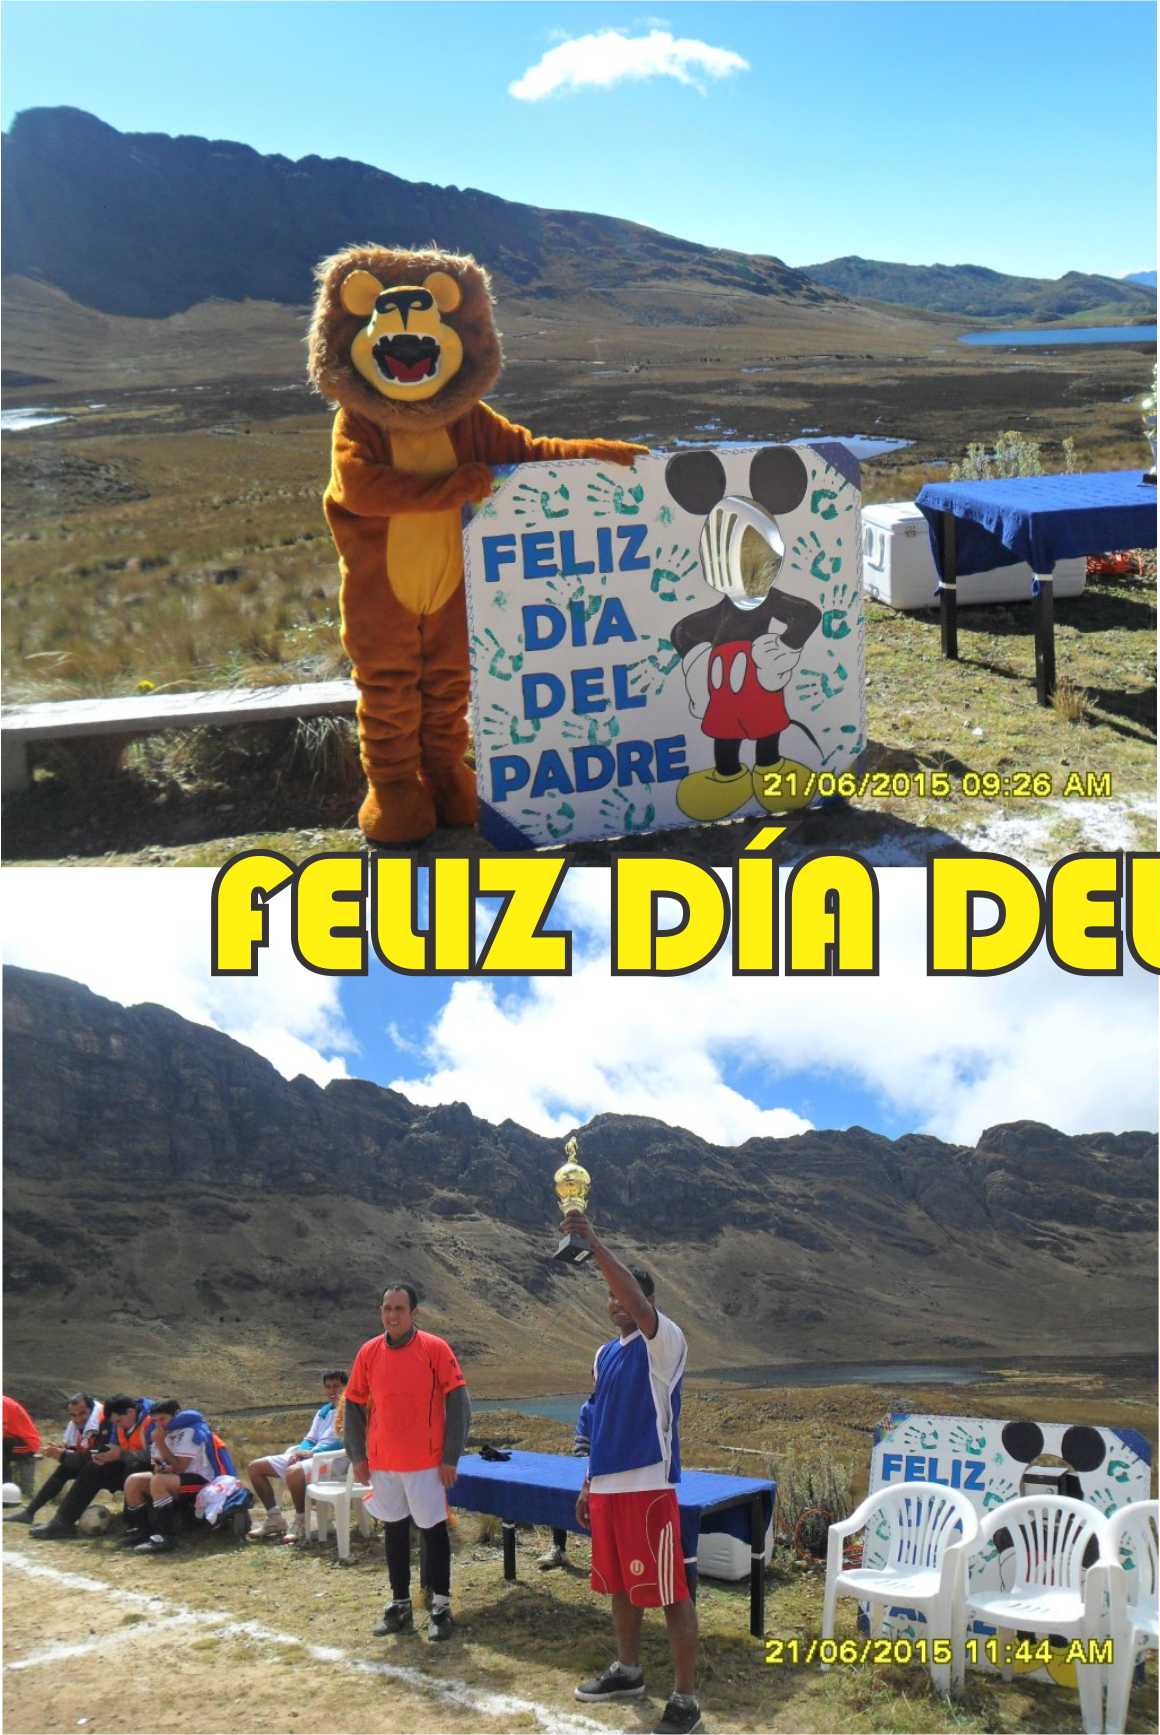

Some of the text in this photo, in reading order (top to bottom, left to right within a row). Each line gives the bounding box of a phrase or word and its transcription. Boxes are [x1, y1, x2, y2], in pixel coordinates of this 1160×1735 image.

[481, 524, 651, 583] FELIZ
[522, 597, 637, 651] DIA
[521, 664, 648, 720] DEL
[490, 734, 690, 802] PADRE
[882, 1453, 986, 1491] FELIZ
